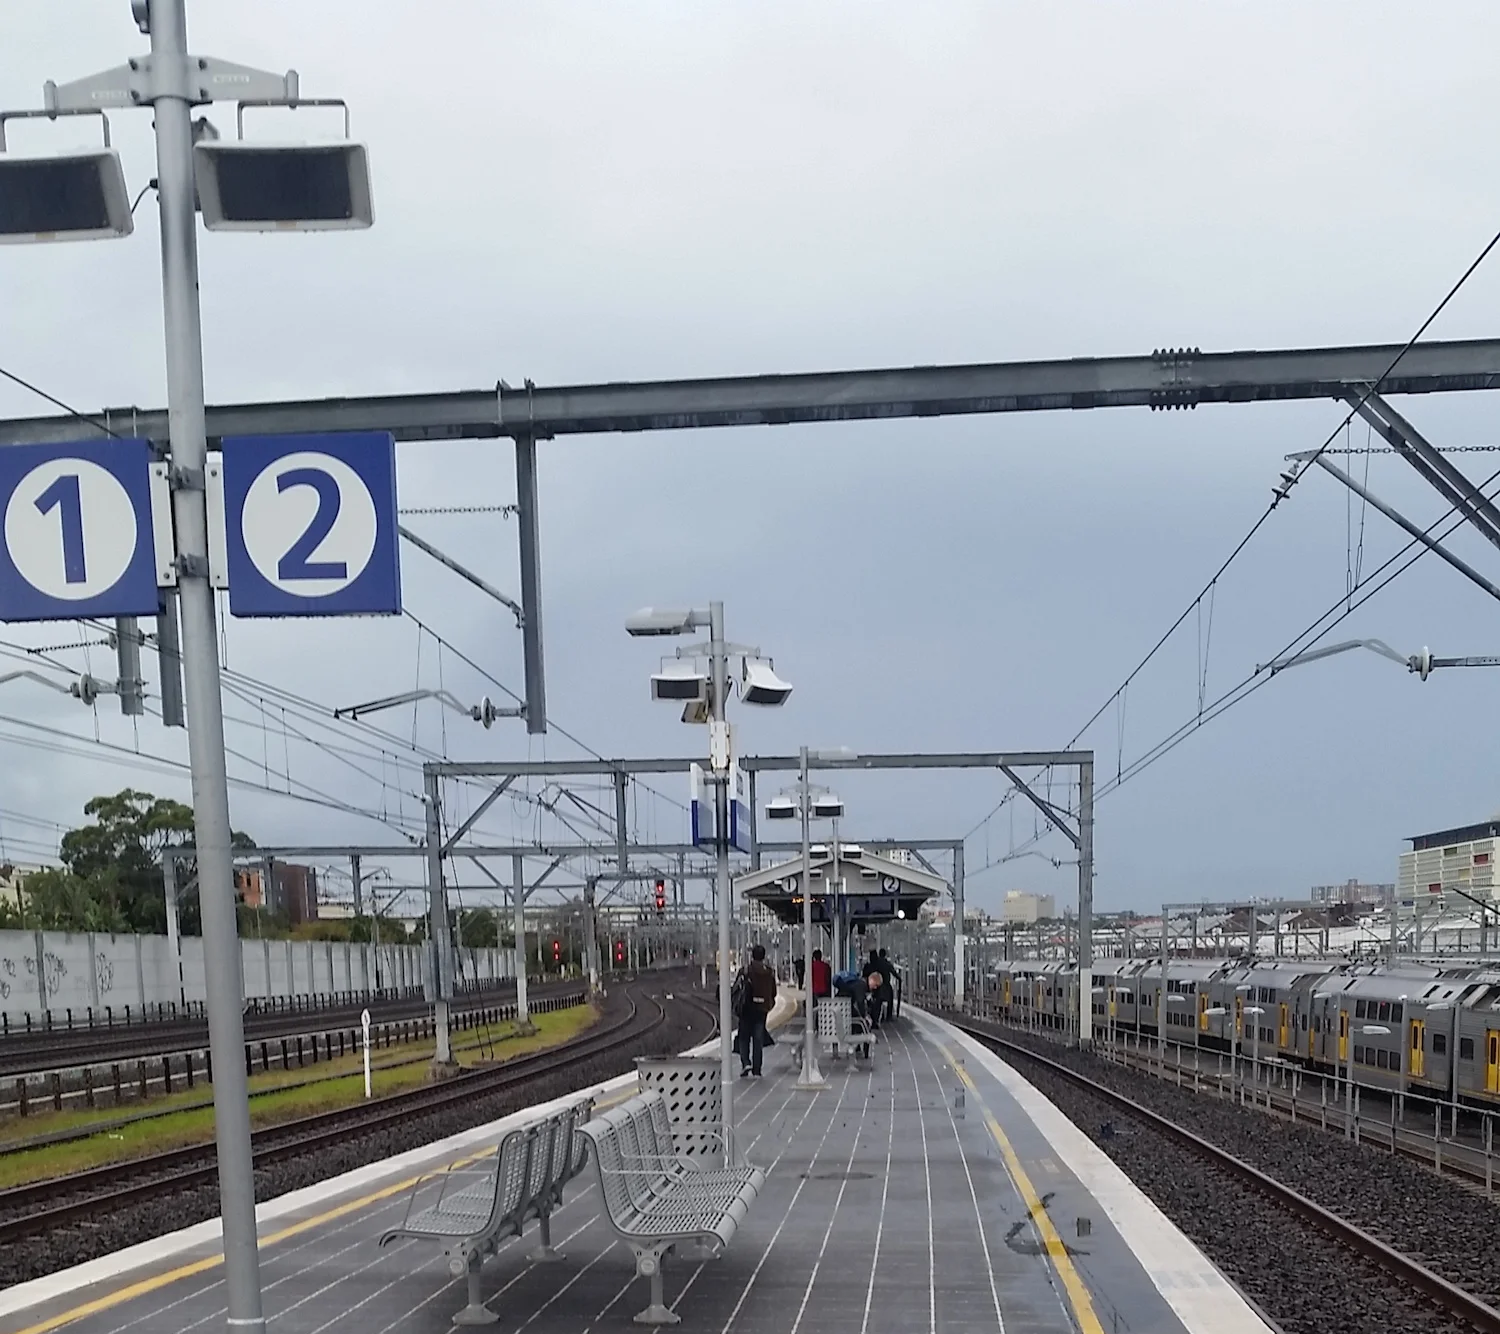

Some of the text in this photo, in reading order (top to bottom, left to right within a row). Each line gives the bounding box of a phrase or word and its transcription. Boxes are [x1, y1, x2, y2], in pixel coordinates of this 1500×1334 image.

[33, 474, 87, 584] 1
[276, 467, 348, 580] 2
[887, 877, 896, 890] 2
